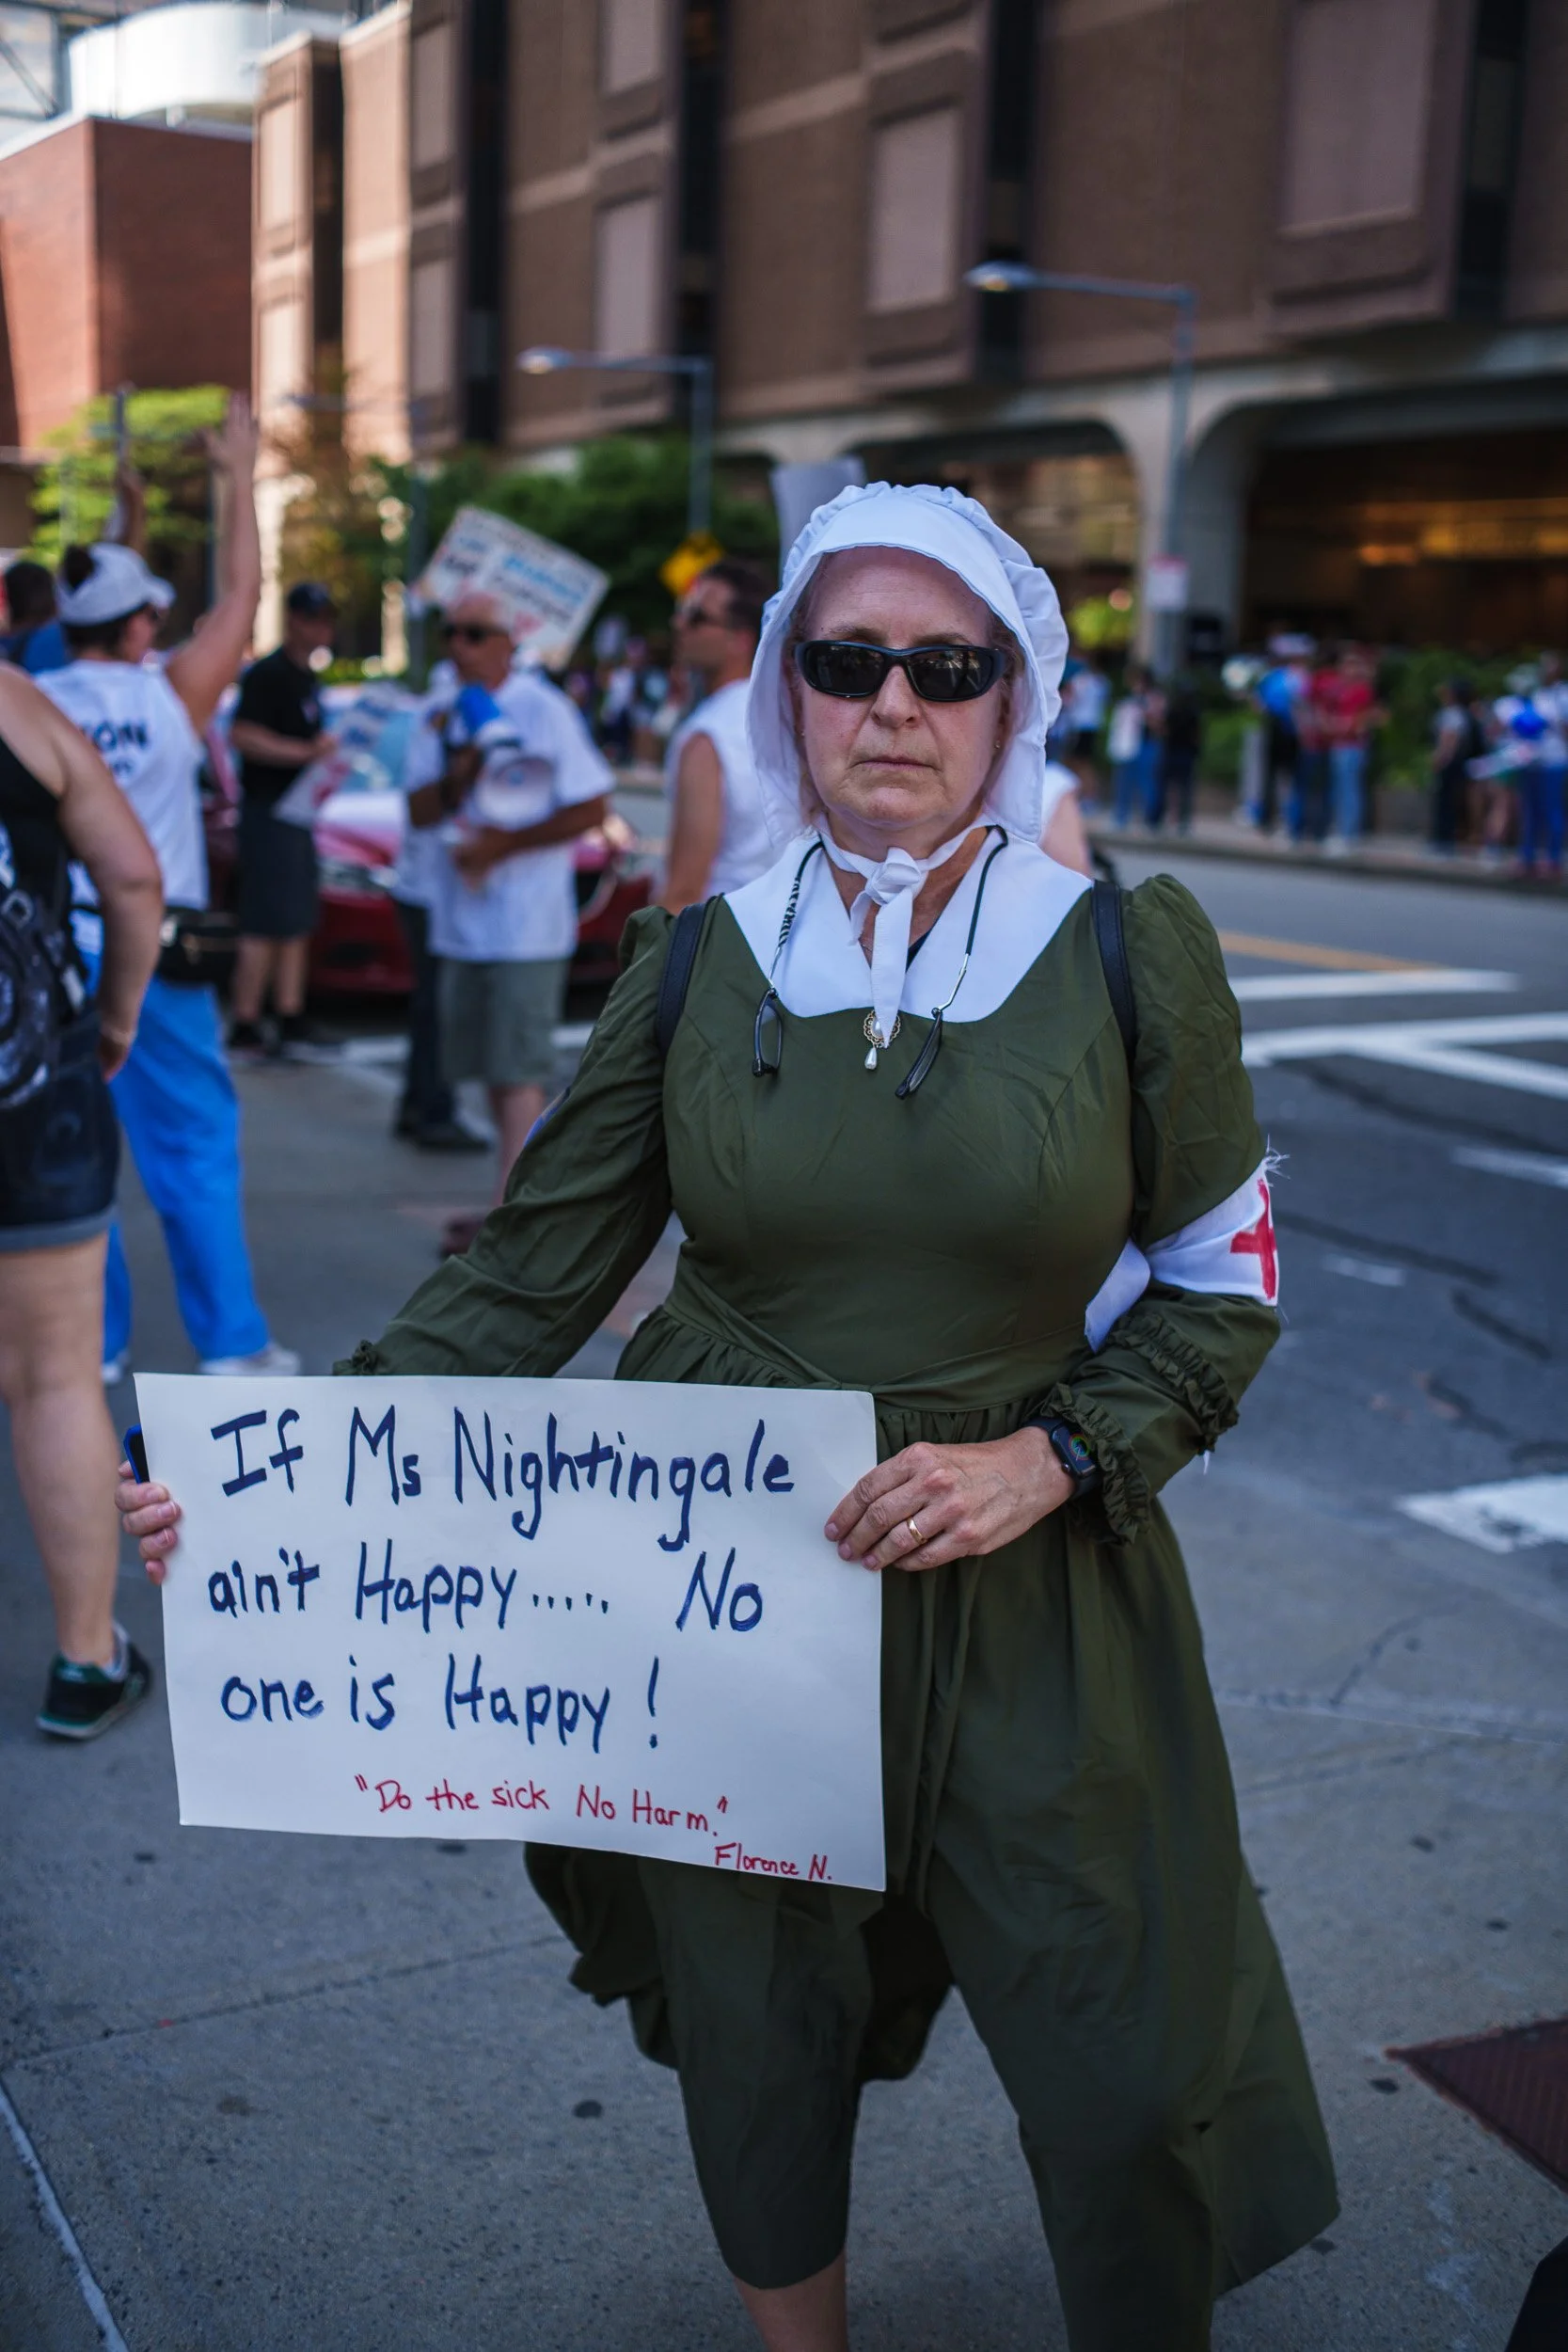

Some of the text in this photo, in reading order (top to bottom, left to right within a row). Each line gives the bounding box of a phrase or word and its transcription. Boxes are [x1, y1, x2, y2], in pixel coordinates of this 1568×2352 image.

[210, 1404, 796, 1553] If Ms Nightingale
[207, 1546, 321, 1619] ain't
[674, 1546, 764, 1633] No
[219, 1675, 325, 1724] one
[348, 1654, 396, 1732] is
[425, 1777, 481, 1812] the
[490, 1779, 550, 1810] sick
[576, 1784, 617, 1820] No
[713, 1841, 832, 1882] Florence N.
